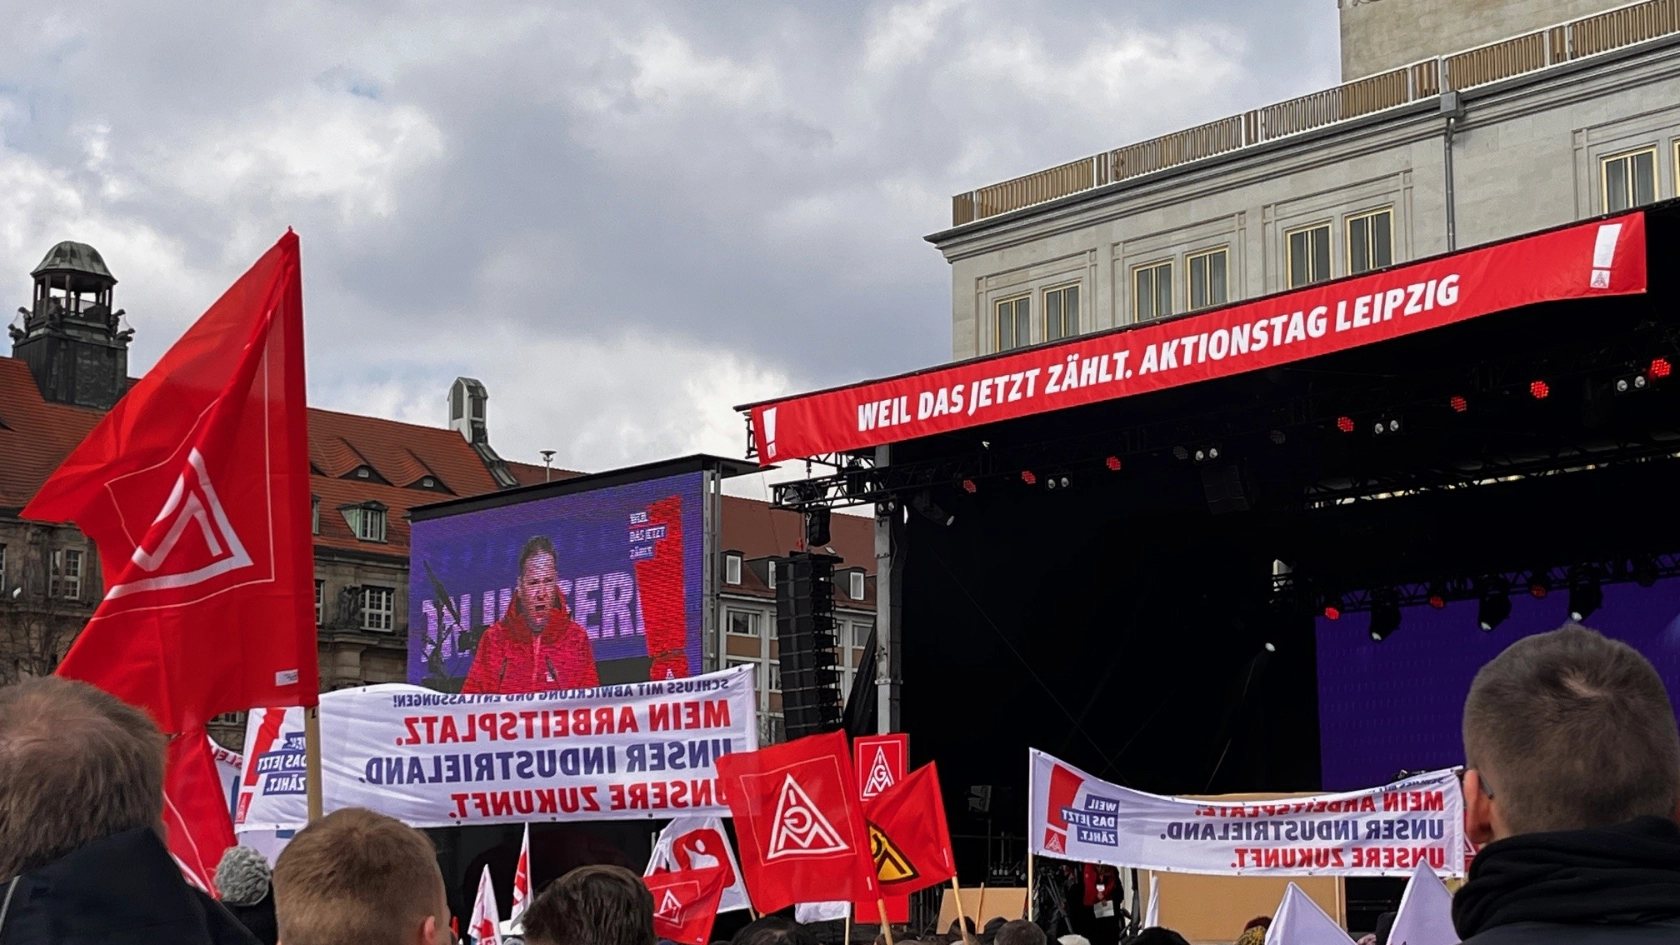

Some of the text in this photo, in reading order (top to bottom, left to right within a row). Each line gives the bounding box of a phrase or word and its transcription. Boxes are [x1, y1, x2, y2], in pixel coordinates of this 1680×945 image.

[857, 273, 1461, 432] WEIL DAS JETZT ZÄHLT. AKTIONSTAG LEIPZIG
